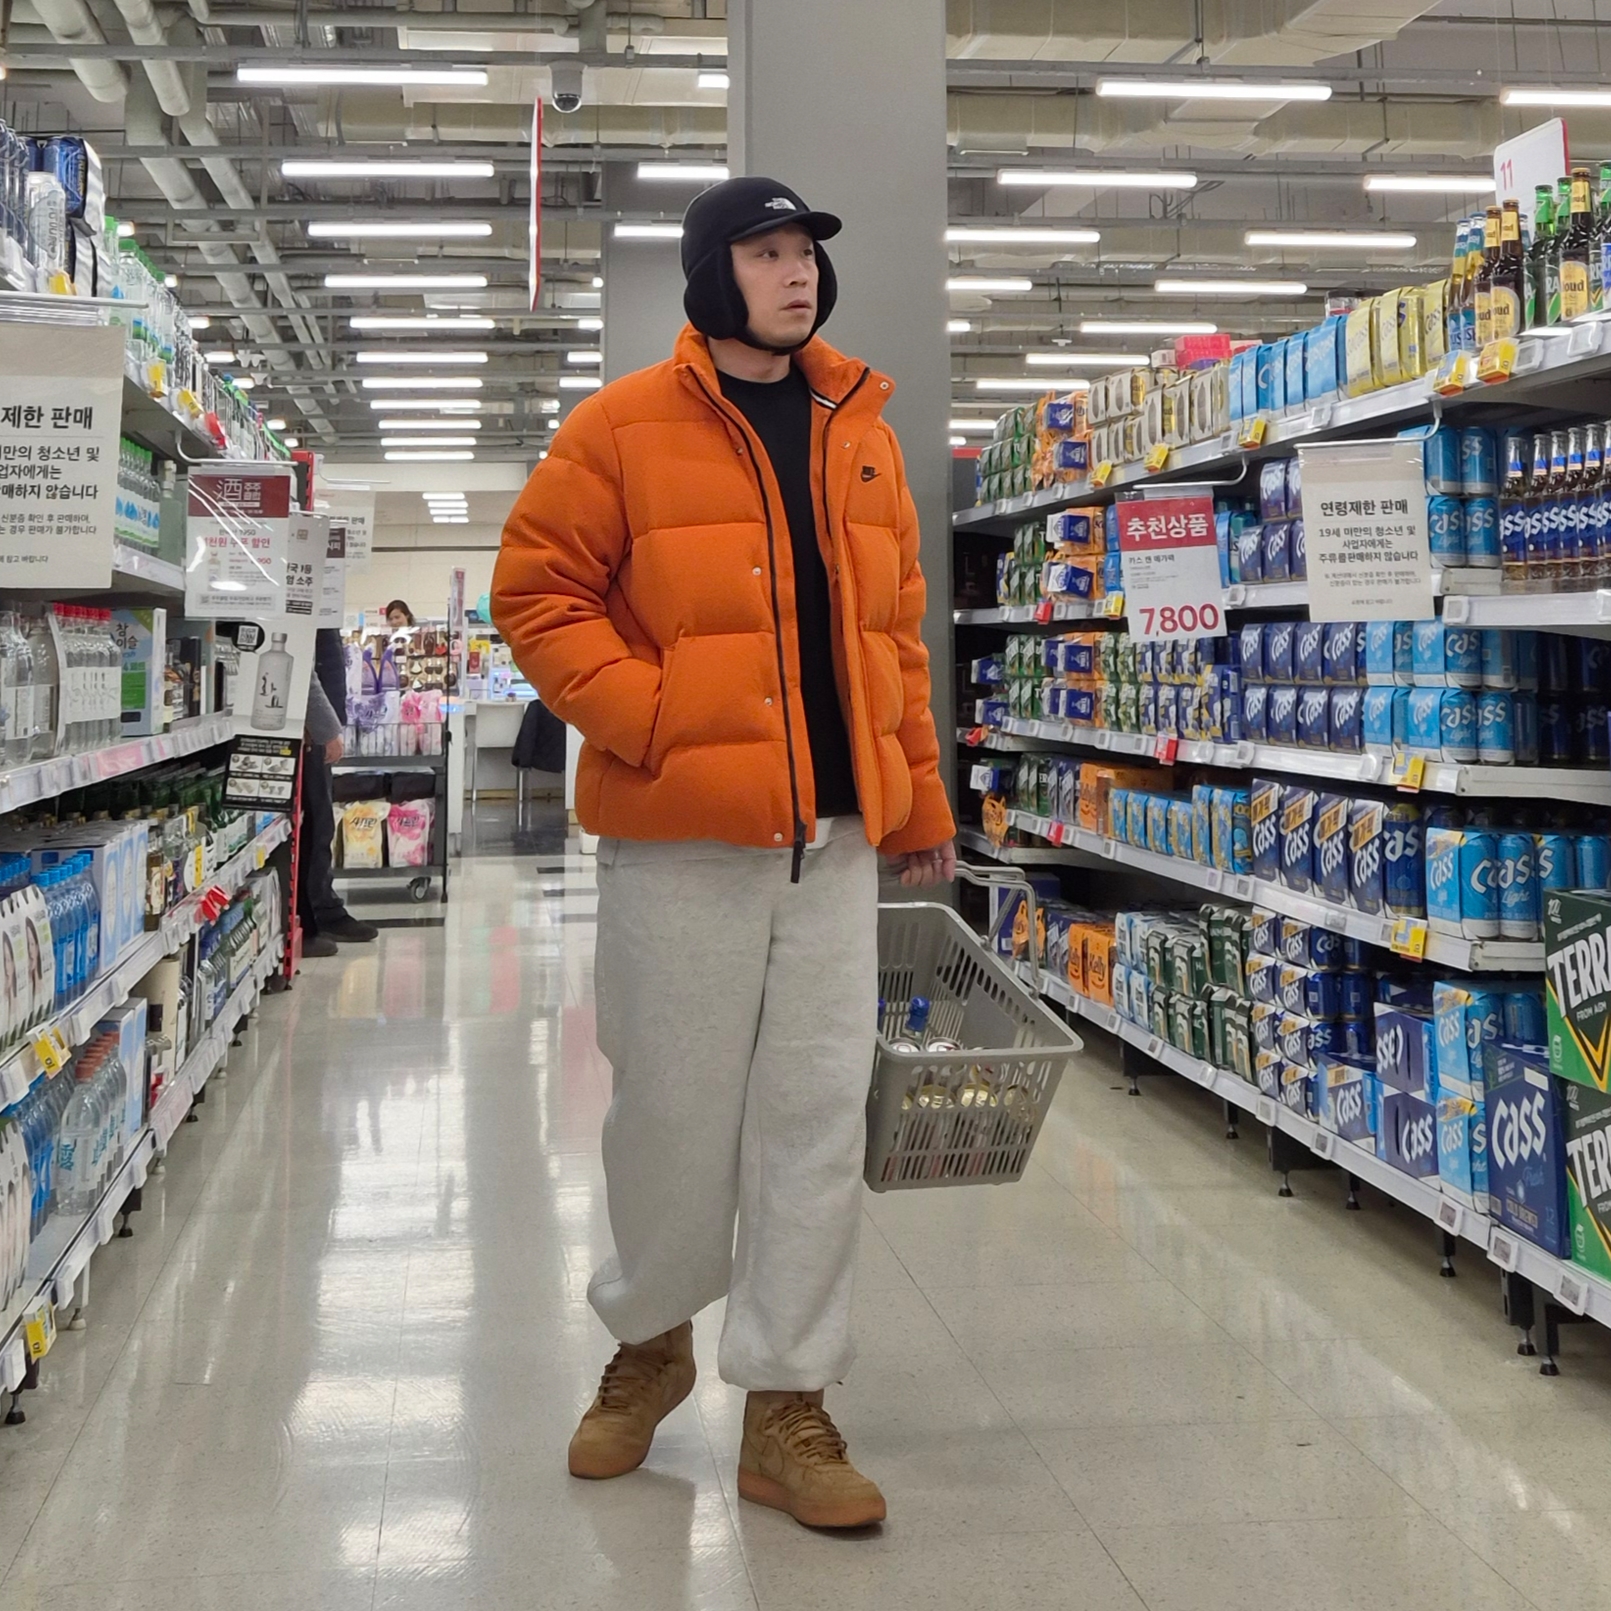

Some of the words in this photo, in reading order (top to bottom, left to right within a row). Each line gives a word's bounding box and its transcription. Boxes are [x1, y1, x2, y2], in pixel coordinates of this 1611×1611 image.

[1500, 159, 1513, 191] 11
[1, 405, 45, 429] 제한
[51, 406, 93, 430] 판매
[0, 445, 32, 461] 만의
[37, 446, 80, 461] 청소년
[86, 447, 99, 462] 및
[0, 483, 41, 499] 매하지
[45, 484, 99, 500] 않습니다
[1320, 500, 1376, 517] 연령제한
[1380, 499, 1408, 515] 판매
[9, 525, 25, 535] 경우
[56, 526, 97, 535] 불가합니다
[1127, 513, 1209, 542] 추천상품
[1267, 524, 1288, 562] Cass
[1319, 527, 1341, 537] 19세
[1343, 526, 1372, 537] 미만의
[1375, 525, 1403, 537] 청소년
[1406, 525, 1416, 536] 및
[1342, 538, 1394, 550] 사업자에게는
[1384, 550, 1419, 562] 않습니다
[296, 576, 313, 587] 소주
[1139, 603, 1219, 637] 7,800
[1271, 626, 1292, 662] Cass
[1300, 624, 1322, 662] Cass
[1332, 623, 1354, 662] Cass
[1306, 689, 1328, 726] Cass
[1441, 704, 1475, 731] Cas
[1253, 814, 1277, 857] Cass
[1285, 822, 1310, 867] Cass
[1321, 830, 1344, 877] Cass
[1353, 838, 1380, 888] Cass
[1430, 852, 1454, 891] Cass
[1439, 1010, 1460, 1048] Cass
[1576, 1006, 1594, 1022] FROM
[1336, 1082, 1362, 1127] Cass
[1402, 1114, 1433, 1164] Cass
[1441, 1119, 1463, 1155] Cass
[1491, 1091, 1546, 1170] Cass
